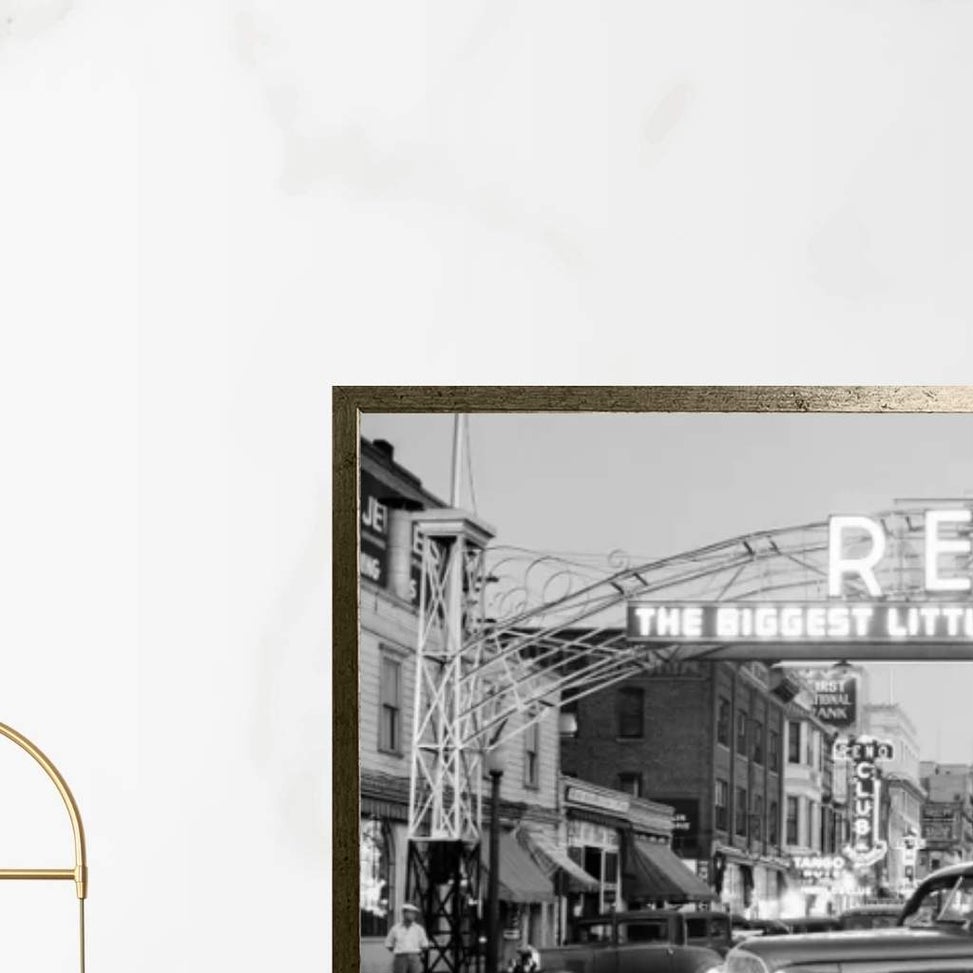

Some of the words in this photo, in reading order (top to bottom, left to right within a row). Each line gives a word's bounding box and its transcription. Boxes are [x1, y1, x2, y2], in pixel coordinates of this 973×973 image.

[634, 607, 704, 636] THE
[716, 607, 873, 636] BIGGEST
[855, 761, 874, 836] CLUB
